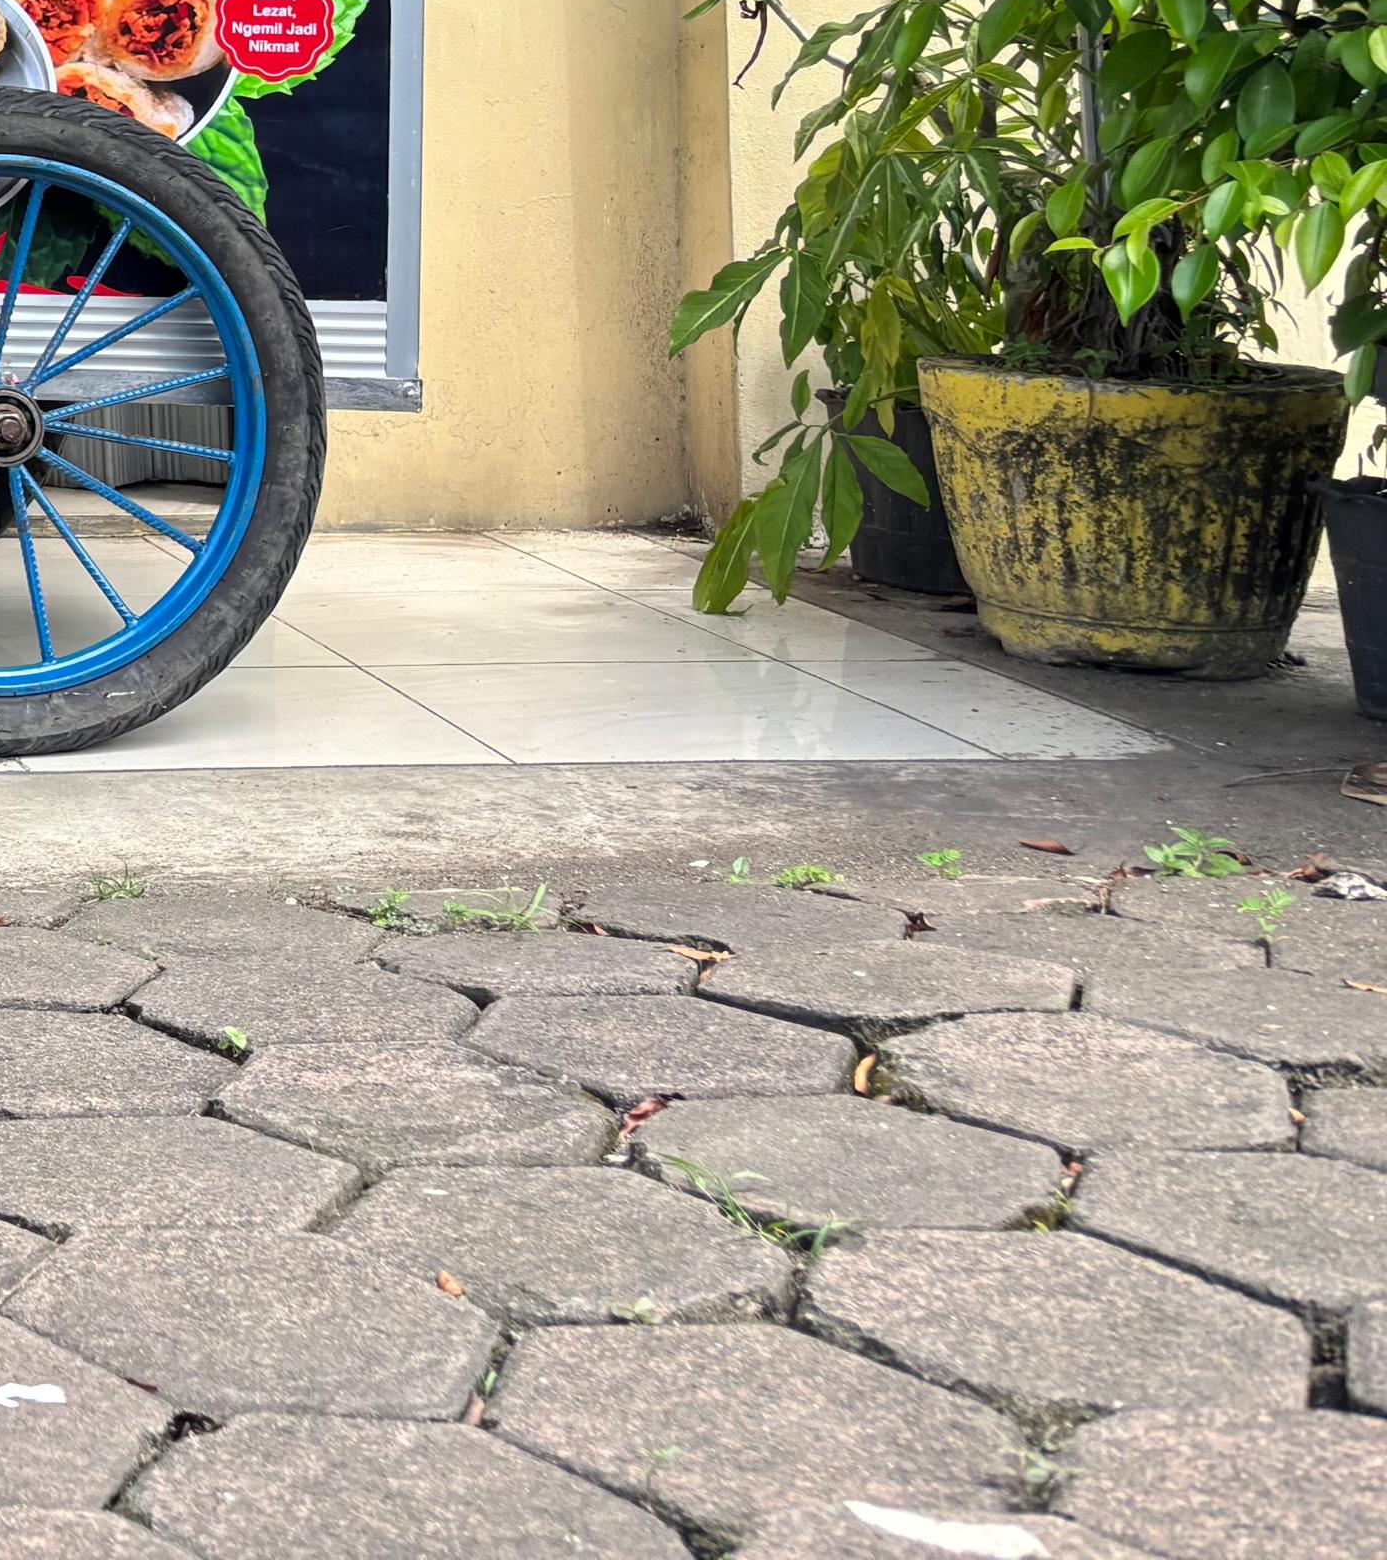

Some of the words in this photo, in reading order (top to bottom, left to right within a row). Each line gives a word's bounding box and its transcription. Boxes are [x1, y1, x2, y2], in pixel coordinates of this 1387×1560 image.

[253, 4, 296, 19] Lezat,
[232, 21, 283, 37] Ngemil
[286, 22, 317, 35] Jadi
[249, 40, 299, 52] Nikmat
